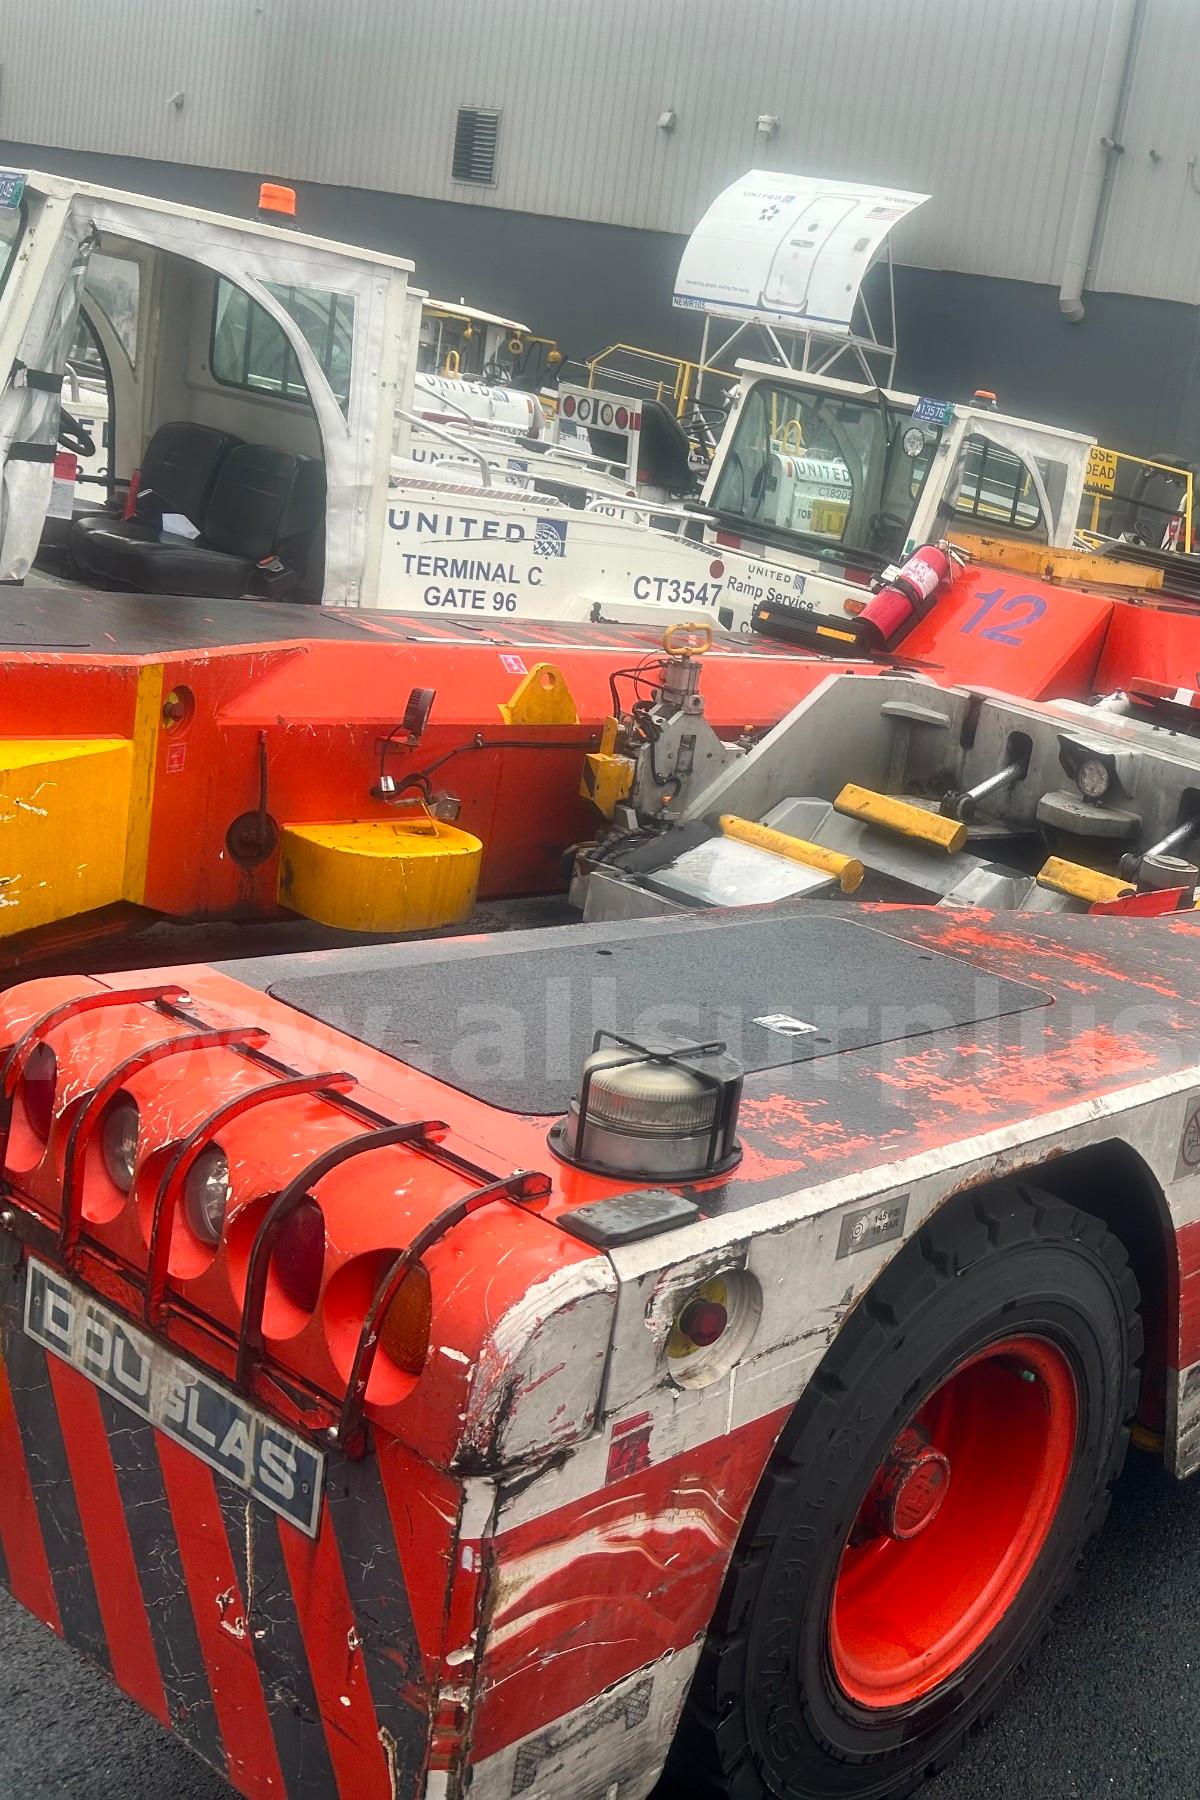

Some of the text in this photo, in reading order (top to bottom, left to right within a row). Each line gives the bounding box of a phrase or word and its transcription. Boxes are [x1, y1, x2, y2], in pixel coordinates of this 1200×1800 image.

[1090, 448, 1113, 463] GSE
[797, 461, 851, 482] UNITED
[388, 508, 525, 542] UNITED
[402, 553, 543, 585] TERMINAL C
[749, 564, 791, 584] UNITED
[424, 586, 517, 611] GATE 96
[634, 575, 723, 606] CT3547
[727, 575, 814, 611] Ramp Service
[960, 588, 1048, 647] 12
[44, 1283, 298, 1501] DOUGLAS
